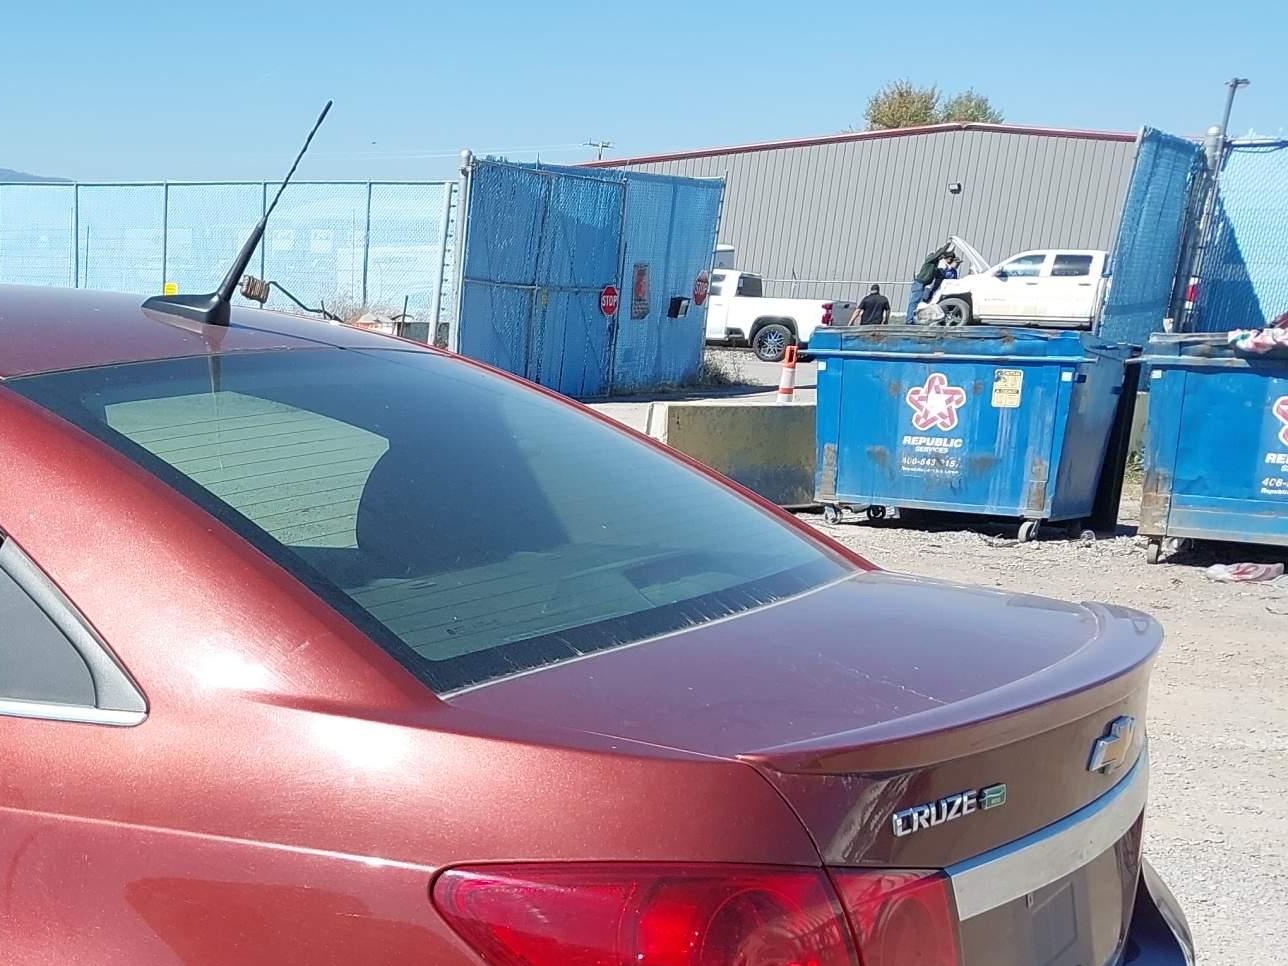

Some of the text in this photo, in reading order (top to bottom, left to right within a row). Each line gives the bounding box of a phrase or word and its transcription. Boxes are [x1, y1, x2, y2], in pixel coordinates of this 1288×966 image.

[601, 295, 617, 307] STOP
[902, 435, 964, 447] REPUBLIC
[915, 446, 948, 454] SERVICES
[892, 789, 977, 837] CRUZE
